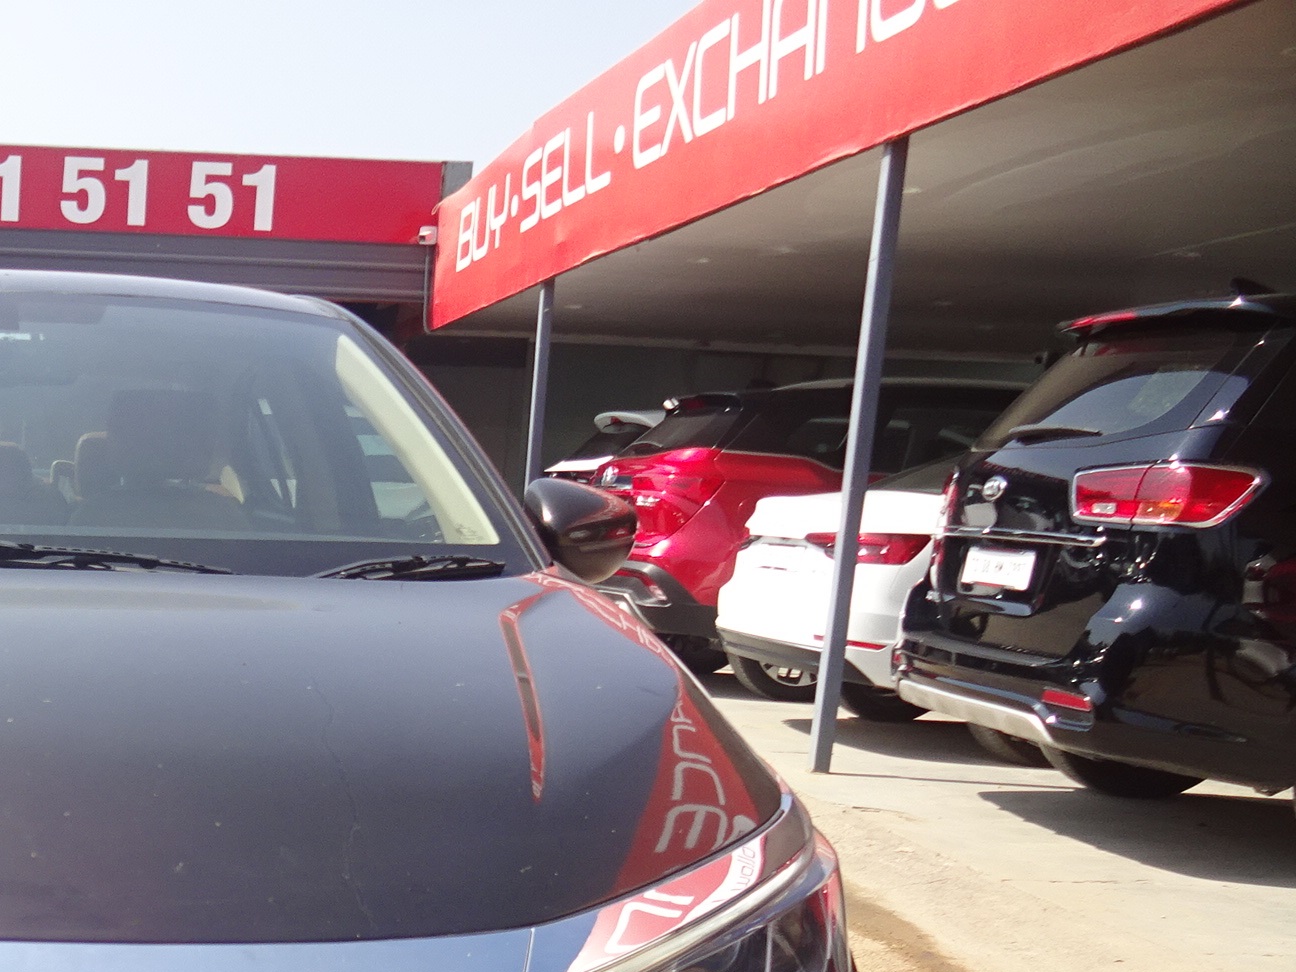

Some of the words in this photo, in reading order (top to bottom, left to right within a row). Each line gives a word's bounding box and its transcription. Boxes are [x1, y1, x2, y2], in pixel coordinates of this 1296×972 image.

[60, 156, 149, 227] 51
[187, 161, 277, 232] 51
[455, 172, 511, 273] BUY
[519, 111, 612, 233] SELL
